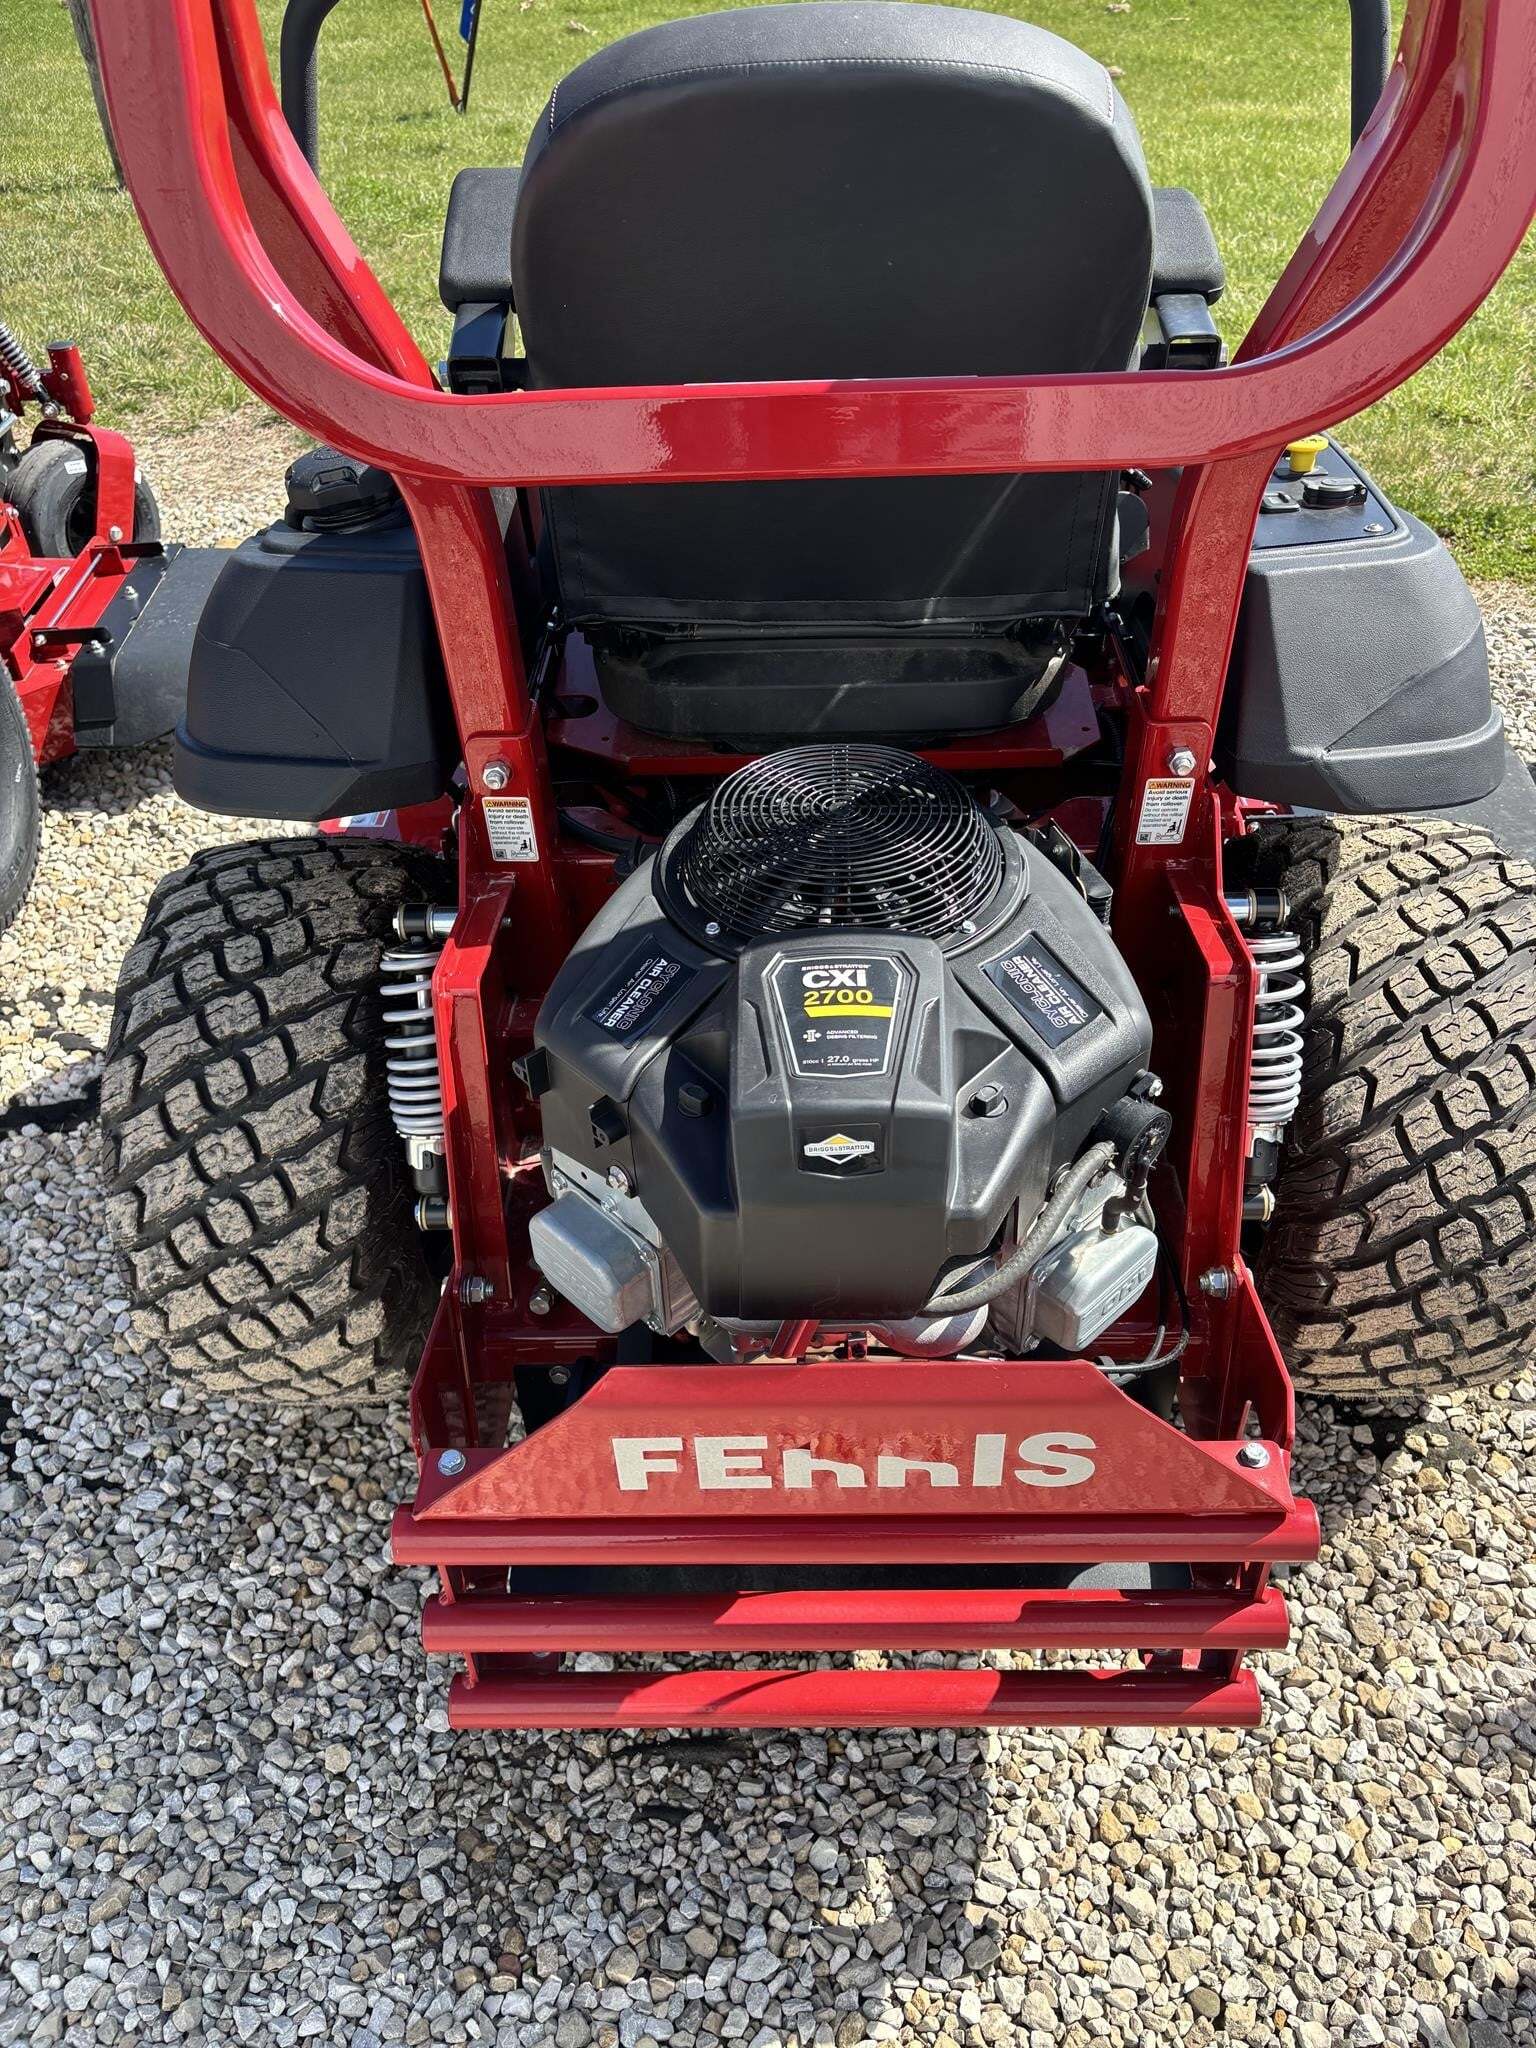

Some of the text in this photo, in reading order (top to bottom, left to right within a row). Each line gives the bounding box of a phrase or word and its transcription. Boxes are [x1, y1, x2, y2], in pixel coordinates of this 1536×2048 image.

[604, 958, 668, 1027] AIR CLEANER
[616, 964, 680, 1030] CYCLONIC
[802, 970, 867, 988] CXI
[804, 989, 873, 1006] 2700
[1000, 960, 1068, 1028] CYCLONIC
[1012, 956, 1082, 1024] AIR CLEANER
[1040, 966, 1060, 986] Longer
[1068, 998, 1088, 1018] Cleaner
